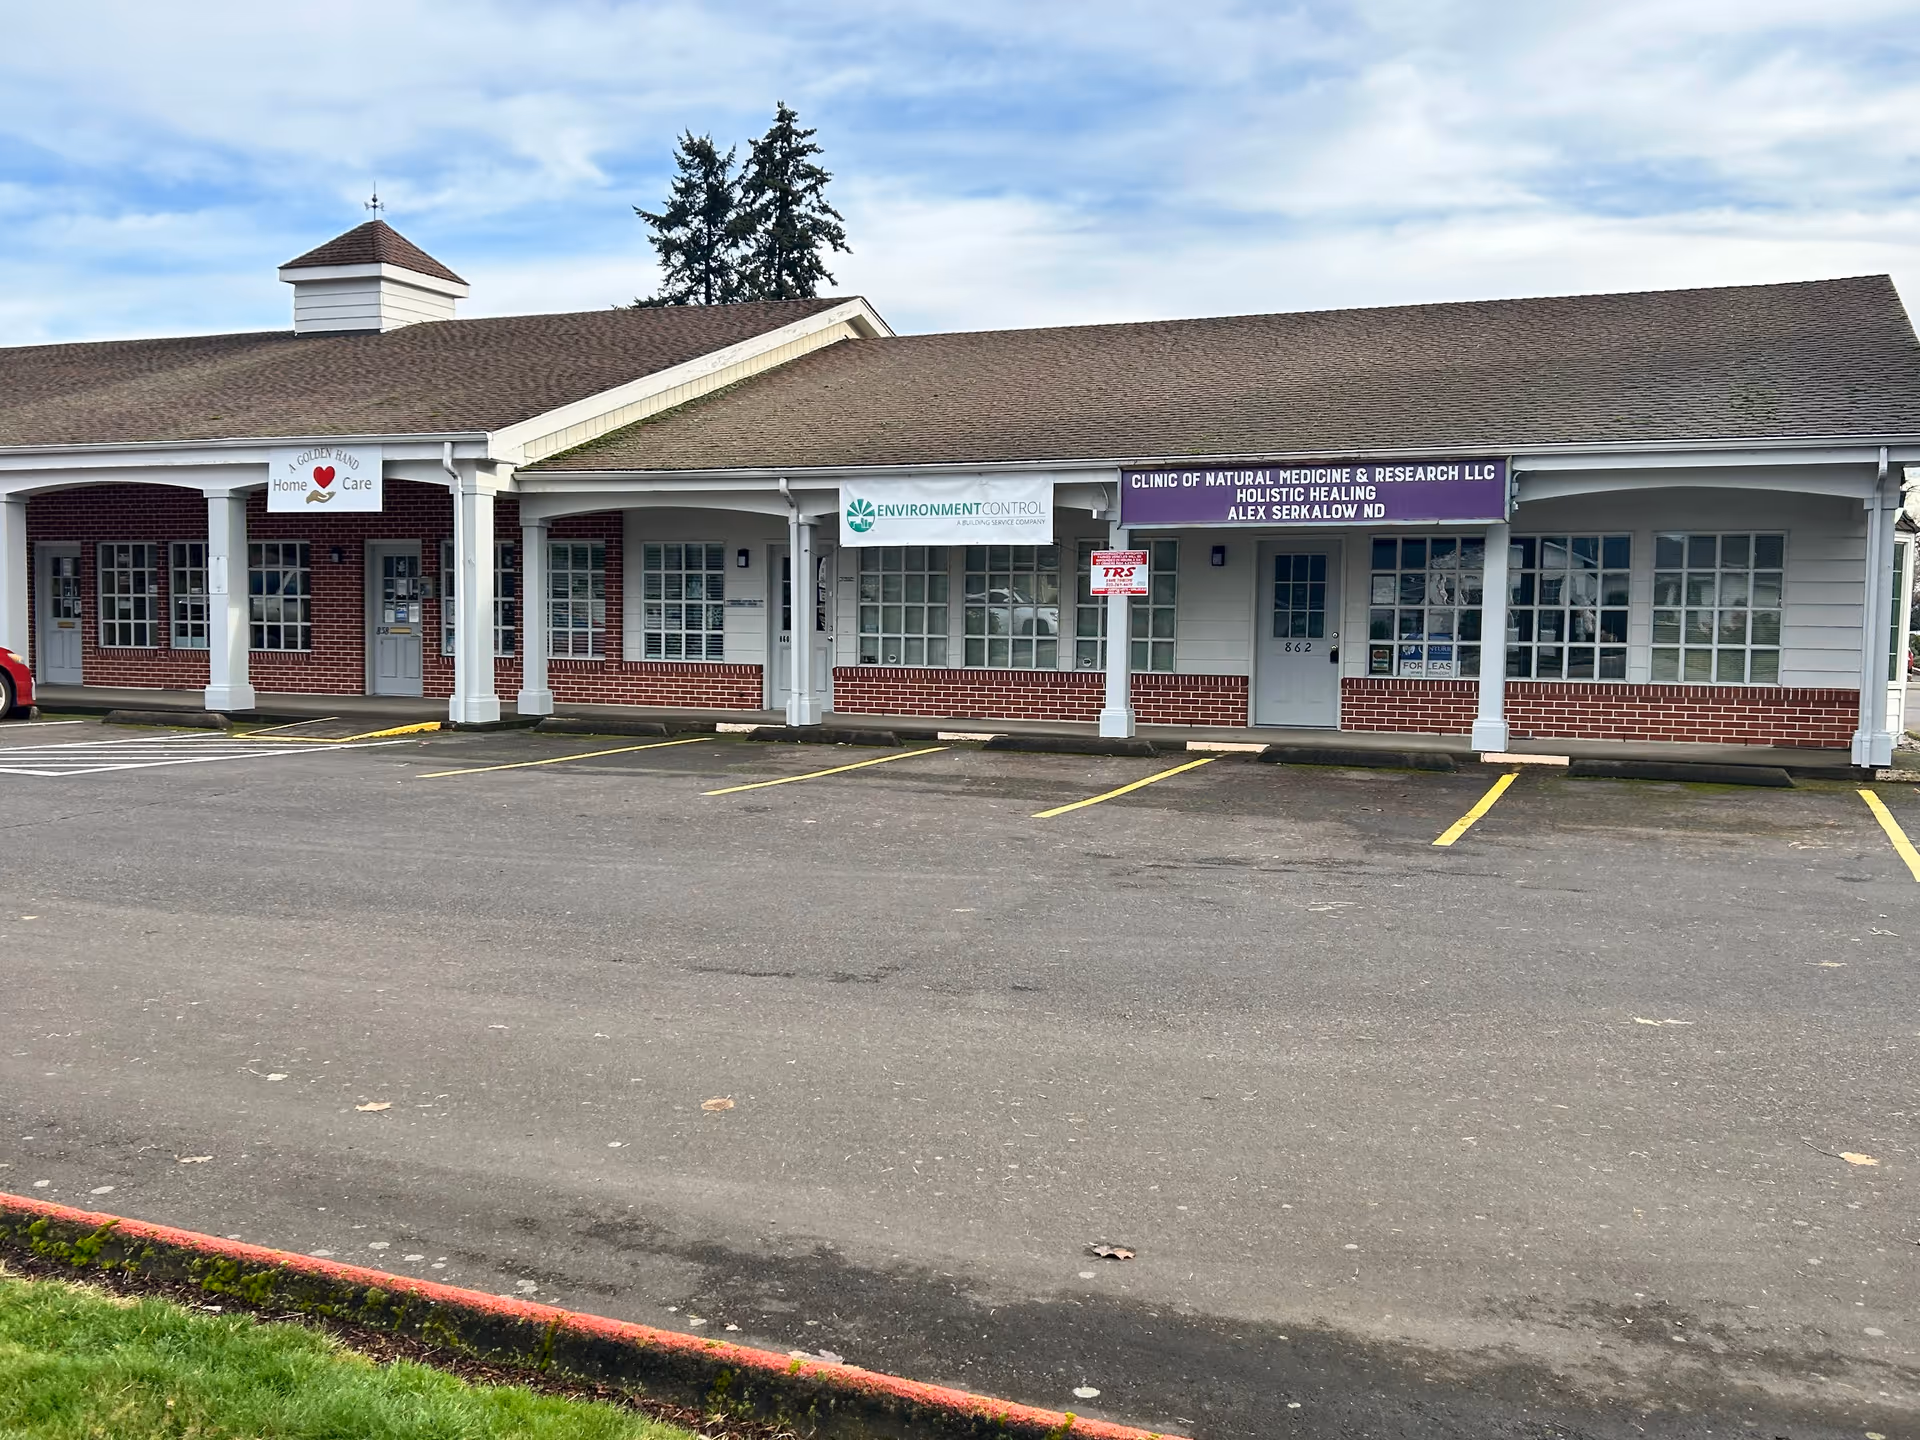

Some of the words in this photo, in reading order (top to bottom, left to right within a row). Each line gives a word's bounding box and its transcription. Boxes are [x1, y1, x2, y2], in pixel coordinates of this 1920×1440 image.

[288, 463, 296, 474] A
[296, 447, 332, 466] GOLDEN
[335, 448, 360, 470] HAND
[273, 478, 308, 491] Home
[342, 476, 372, 490] Care
[1131, 473, 1178, 488] CLINIC
[1182, 472, 1201, 487] OF
[1205, 470, 1274, 487] NATURAL
[1279, 468, 1351, 485] MEDICINE
[1355, 467, 1369, 483] &
[1375, 465, 1459, 482] RESEARCH
[1464, 464, 1496, 481] LLC
[1236, 487, 1305, 503] HOLISTIC
[1309, 485, 1377, 502] HEALING
[1227, 505, 1267, 521] ALEX
[1271, 504, 1358, 520] SERKALOW
[1363, 503, 1386, 518] ND
[1015, 518, 1046, 526] COMPANY
[1103, 566, 1136, 578] TRS
[1284, 641, 1312, 653] 862
[1403, 661, 1423, 670] FOR
[1427, 662, 1455, 670] EAS
